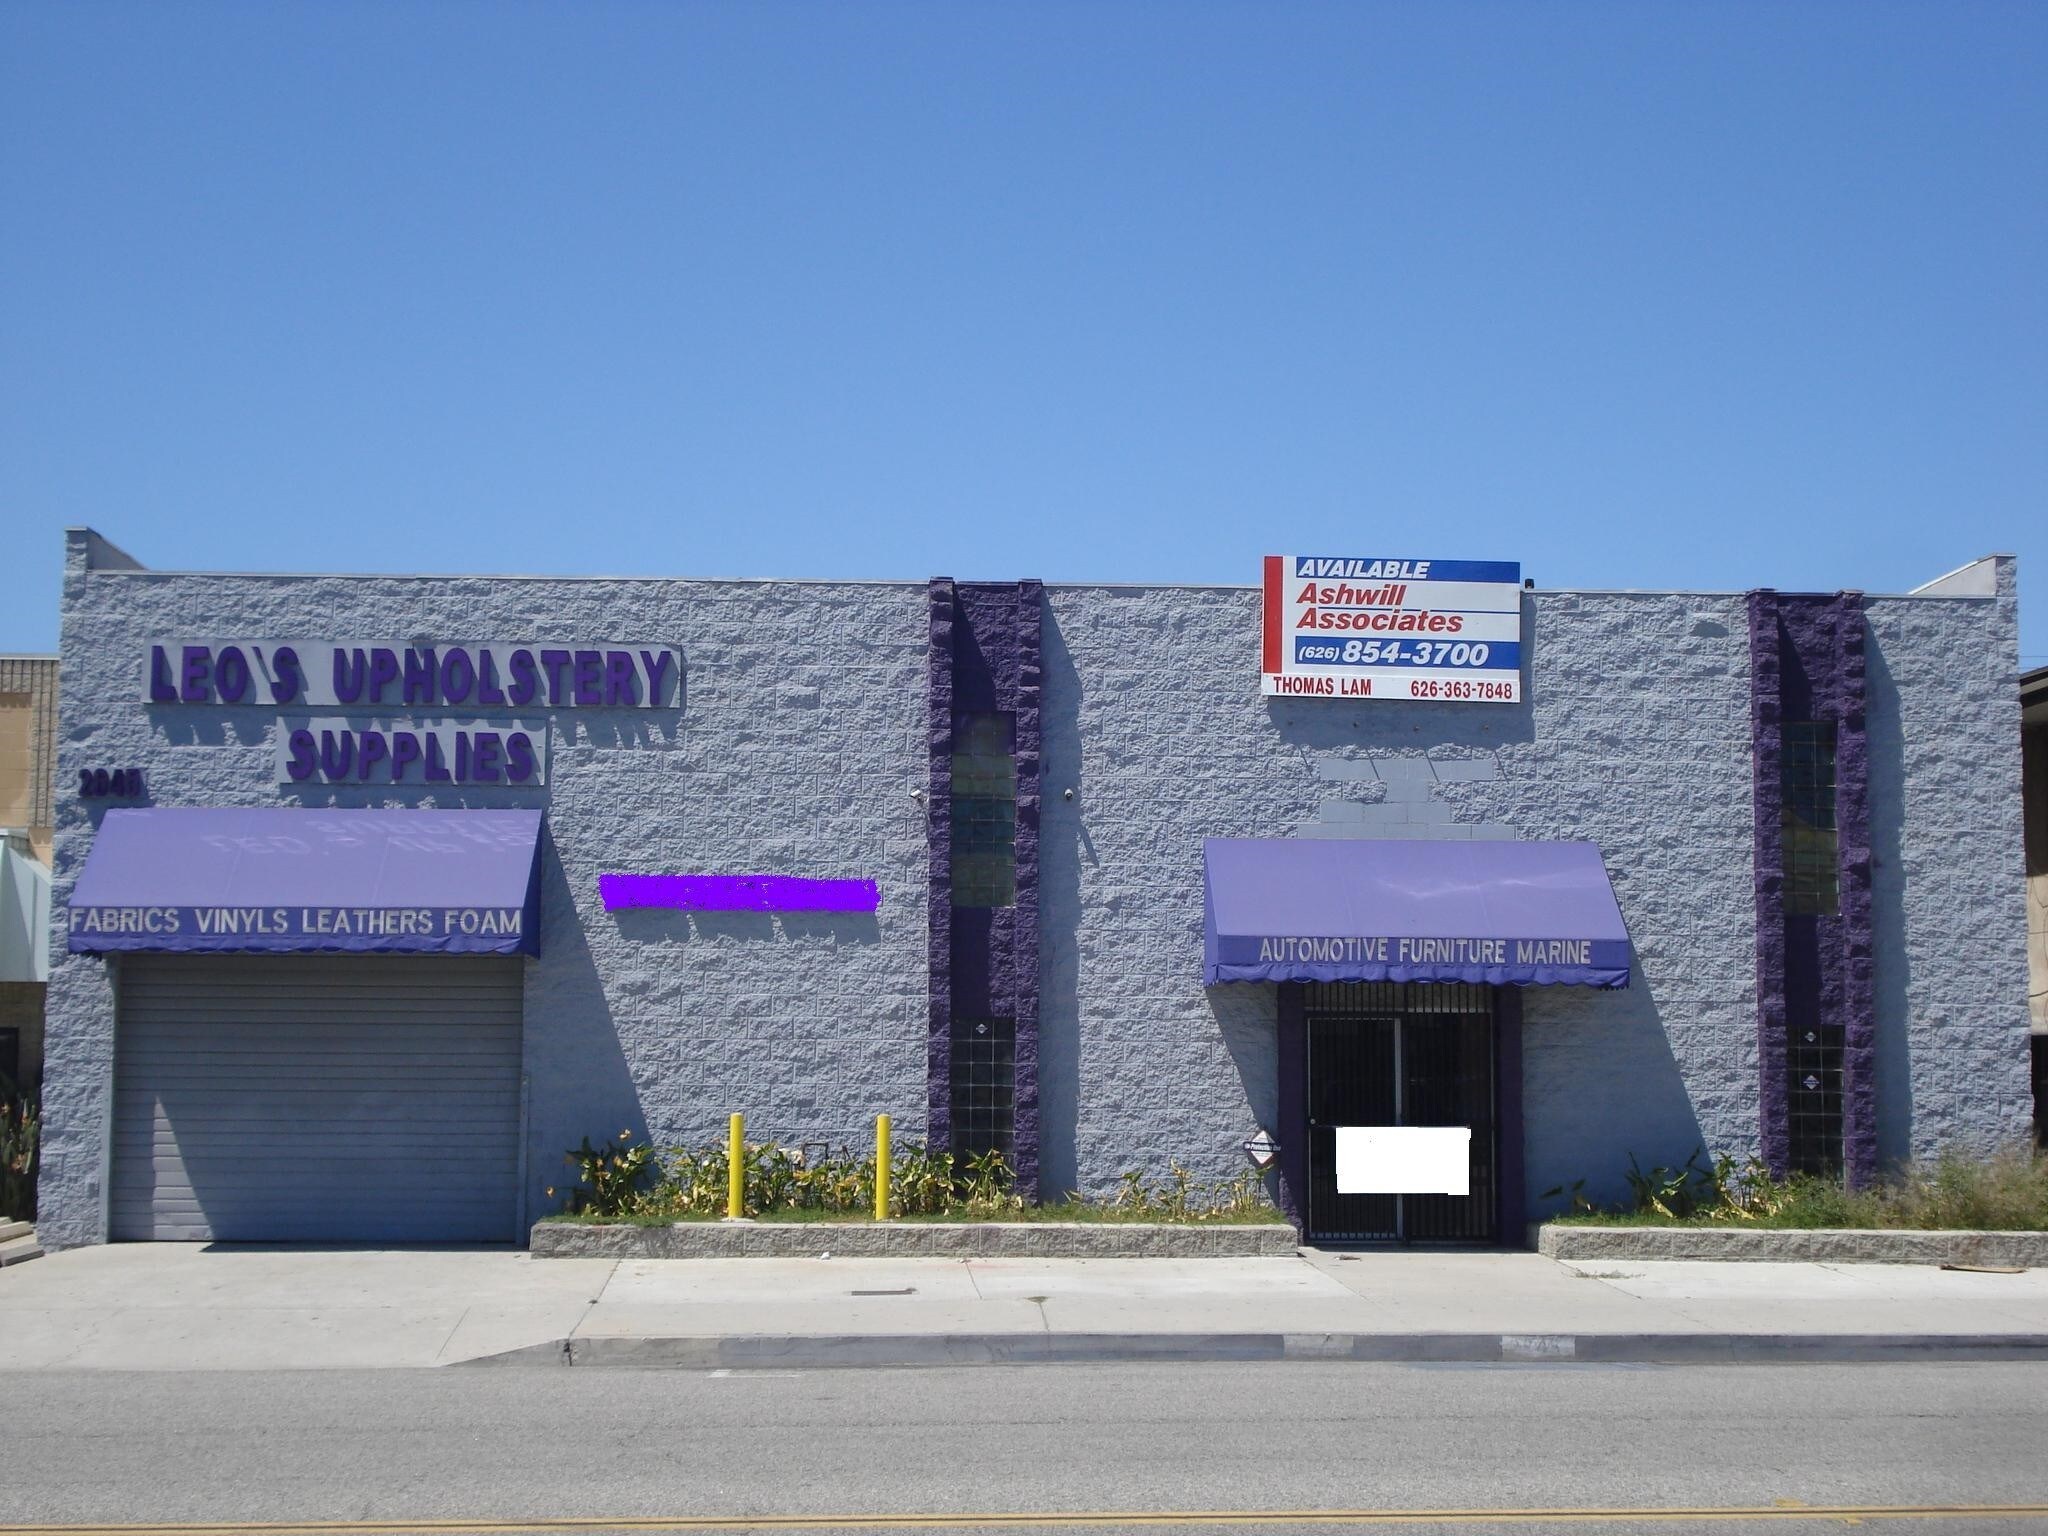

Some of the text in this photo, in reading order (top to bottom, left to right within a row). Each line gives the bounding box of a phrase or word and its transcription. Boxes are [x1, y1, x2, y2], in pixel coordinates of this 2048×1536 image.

[1298, 561, 1430, 580] AVAILABLE
[1296, 582, 1407, 606] Ashwill
[1296, 607, 1464, 632] Associates
[1299, 640, 1490, 666] (626) 854-3700
[151, 645, 673, 708] LEO'S UPHOLSTERY
[1273, 676, 1372, 696] THOMAS LAM
[1411, 680, 1513, 700] 626-363-7848
[285, 729, 533, 783] SUPPLIES
[69, 907, 521, 934] FABRICS VINYLS LEATHERS FOAM
[1259, 936, 1593, 966] AUTOMOTIVE FURNITURE MARINE
